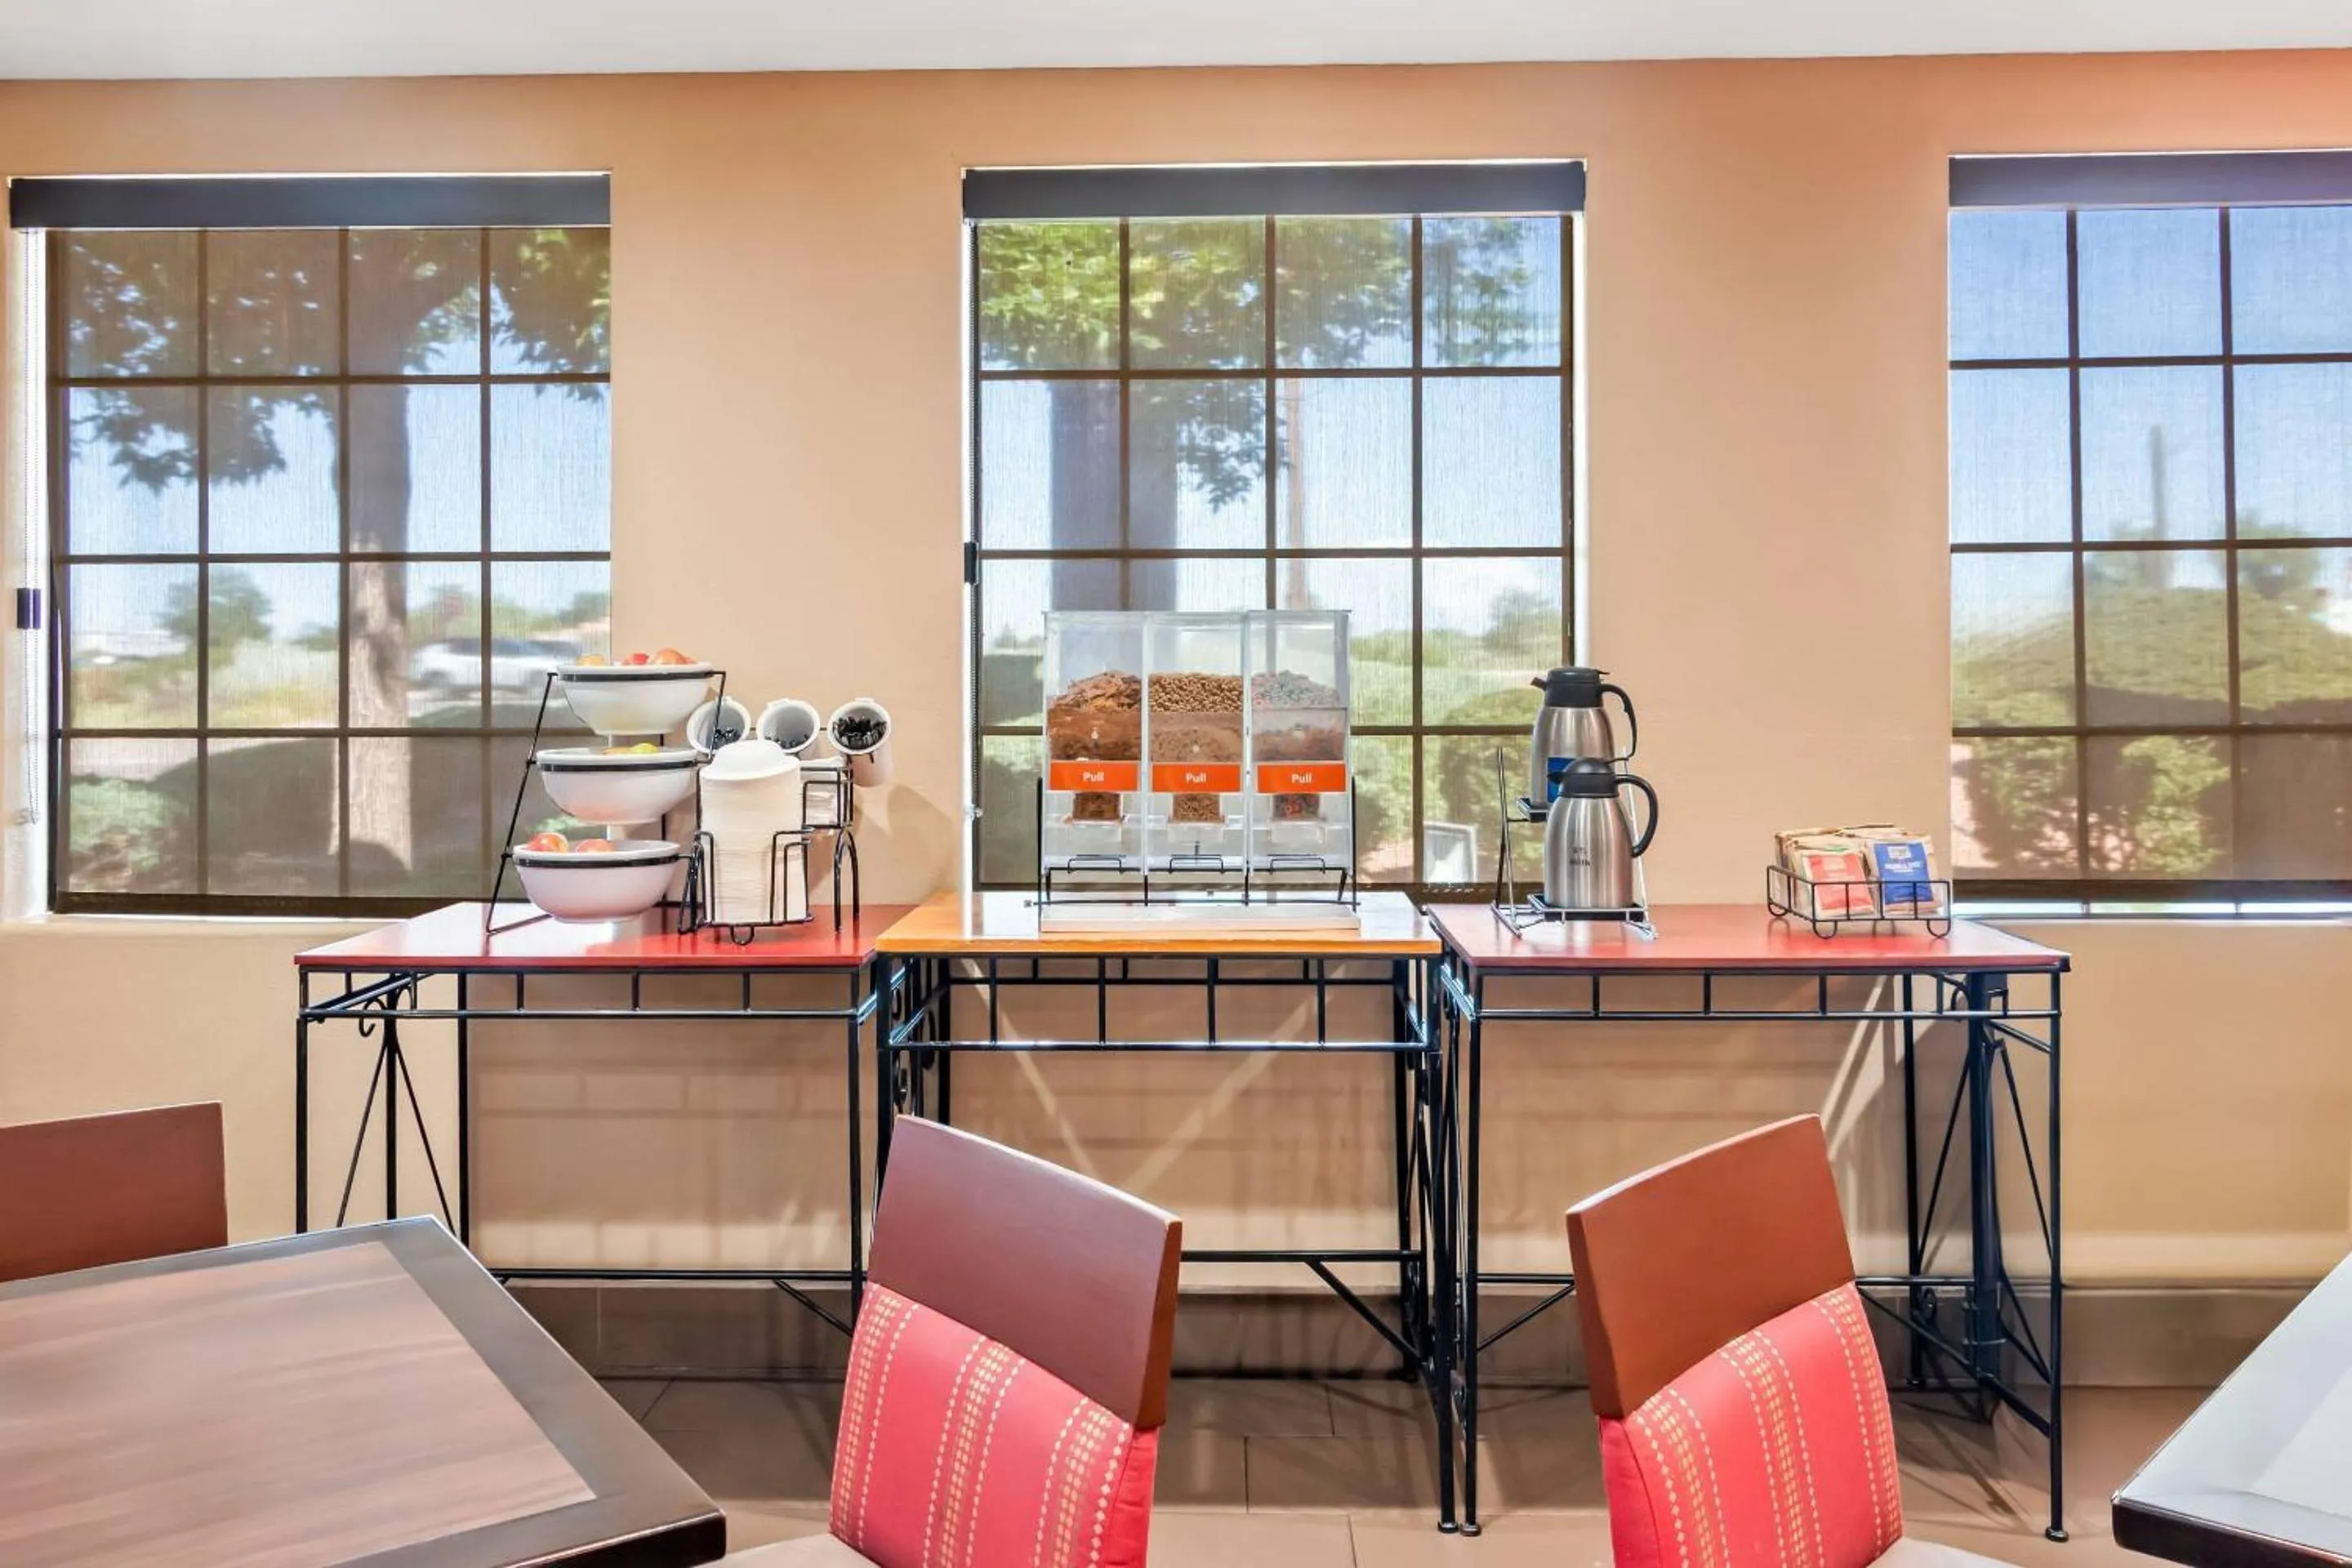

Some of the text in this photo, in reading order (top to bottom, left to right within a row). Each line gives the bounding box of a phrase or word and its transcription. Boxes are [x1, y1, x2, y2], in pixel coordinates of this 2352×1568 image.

[1083, 771, 1104, 782] Pull
[1186, 772, 1206, 783] Pull
[1291, 773, 1312, 783] Pull
